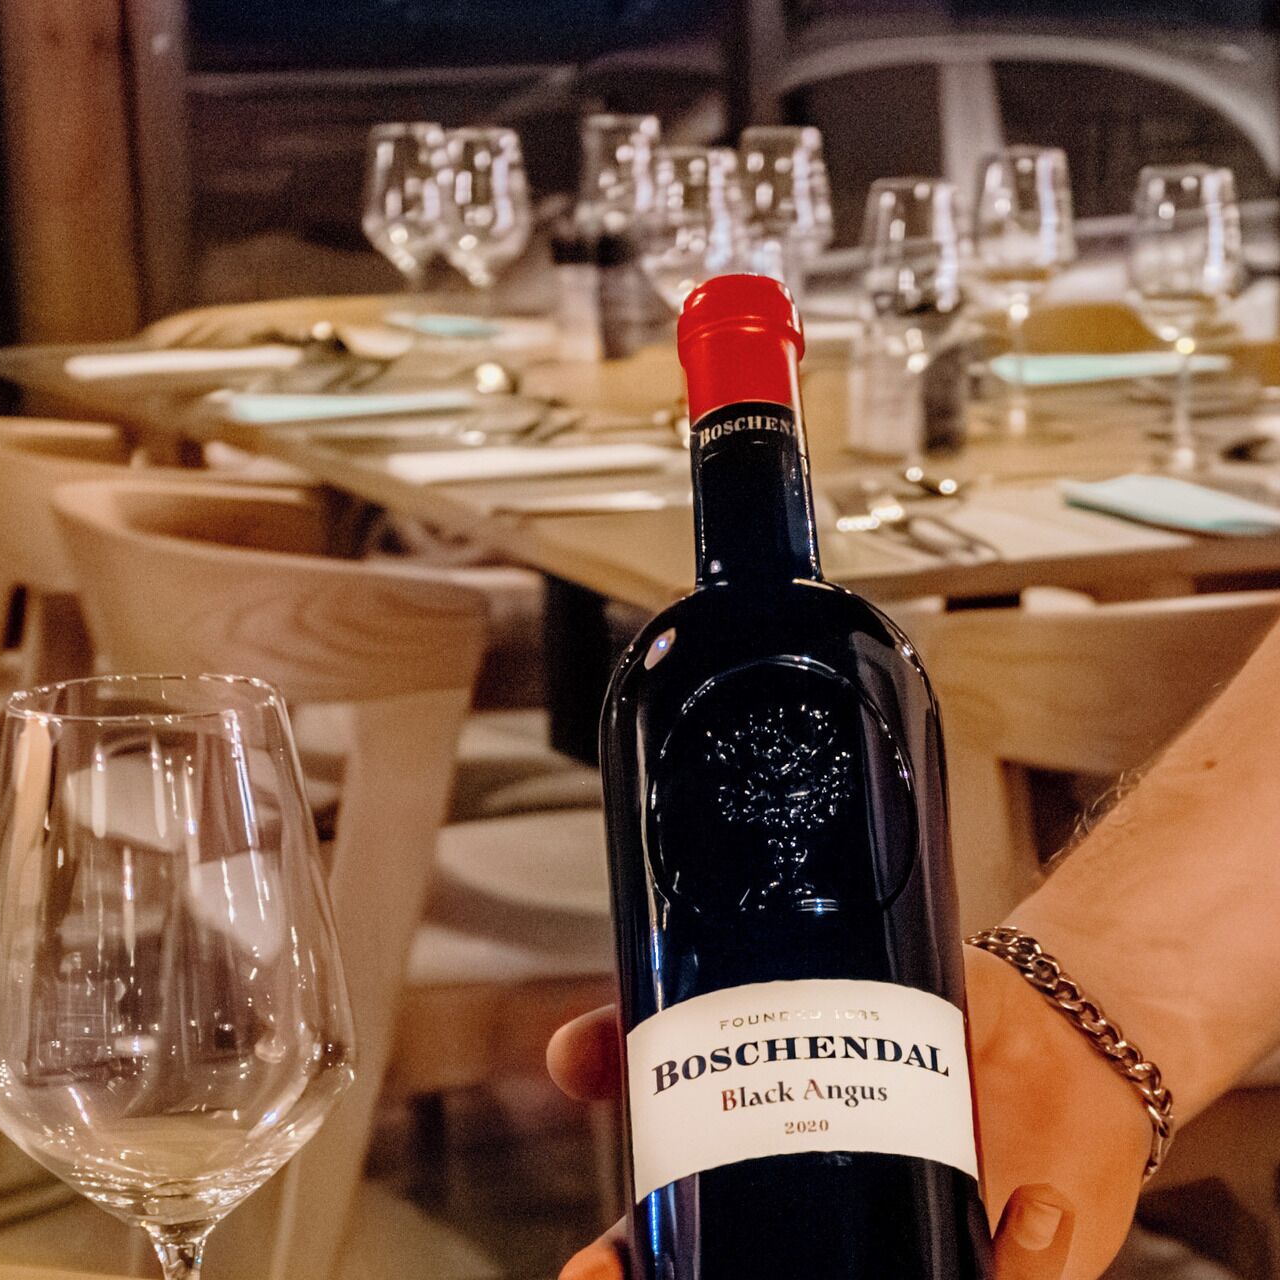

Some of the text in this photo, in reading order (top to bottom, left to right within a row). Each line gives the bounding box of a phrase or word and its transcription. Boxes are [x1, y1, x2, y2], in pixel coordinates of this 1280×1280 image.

[700, 416, 796, 450] BOSCHEN
[652, 1035, 950, 1096] BOSCHENDAL
[721, 1079, 888, 1111] Black Angus
[784, 1119, 830, 1135] 2020
